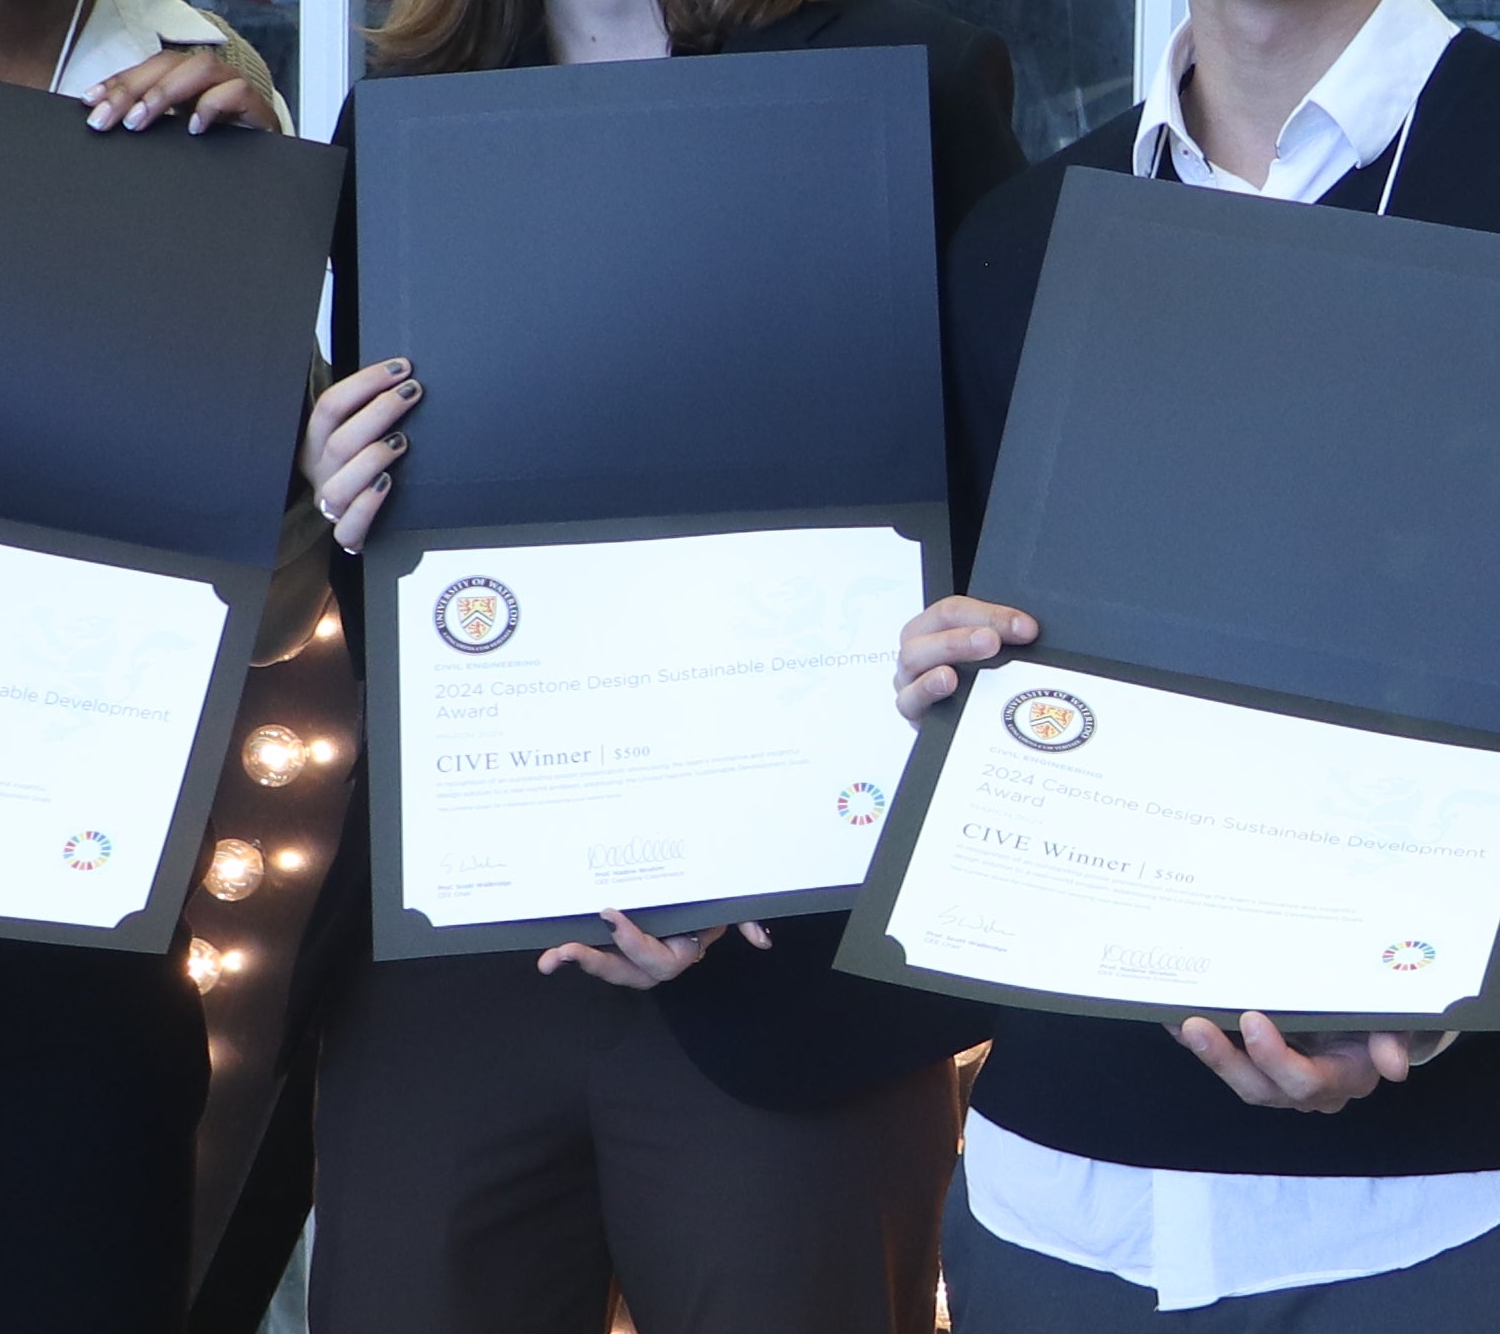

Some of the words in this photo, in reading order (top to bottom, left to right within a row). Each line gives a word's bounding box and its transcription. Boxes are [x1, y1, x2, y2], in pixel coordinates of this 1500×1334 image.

[435, 579, 470, 628] UNIVERSITY
[471, 578, 486, 586] OF
[435, 682, 484, 700] 2024
[490, 677, 581, 699] Capstone
[586, 671, 652, 693] Design
[657, 657, 765, 683] Sustainable
[770, 648, 899, 674] Development
[44, 690, 173, 724] Development
[435, 703, 499, 720] Award
[1004, 690, 1051, 721] UNIVERSITY
[1053, 691, 1068, 700] OF
[436, 752, 500, 773] CIVE
[508, 749, 592, 768] Winner
[613, 746, 651, 760] $500
[976, 781, 1046, 809] Award
[981, 763, 1034, 786] 2024
[1041, 777, 1139, 812] Capstone
[1145, 799, 1215, 828] Design
[1222, 814, 1341, 847] Sustainable
[1346, 835, 1488, 860] Development
[961, 822, 1031, 852] CIVE
[1042, 839, 1131, 874] Winner
[1153, 868, 1195, 885] $500
